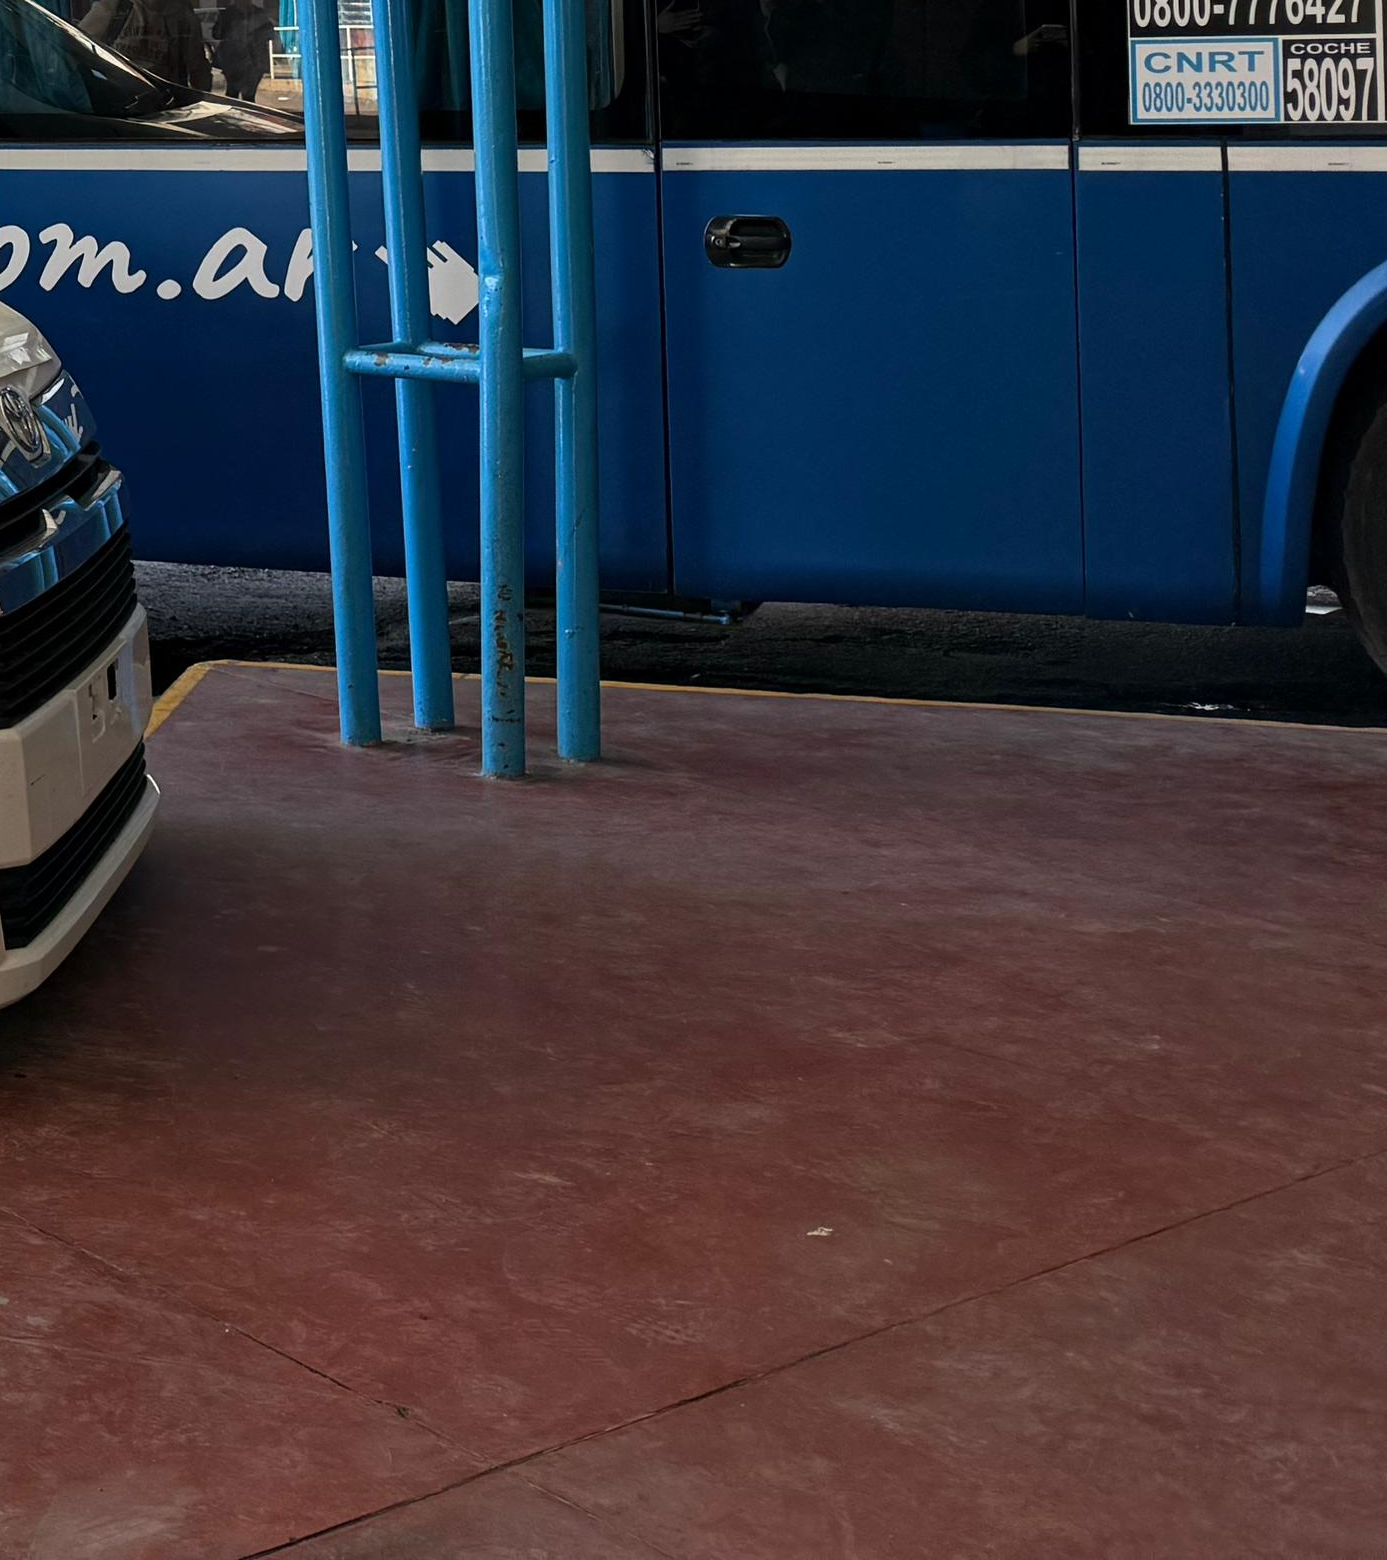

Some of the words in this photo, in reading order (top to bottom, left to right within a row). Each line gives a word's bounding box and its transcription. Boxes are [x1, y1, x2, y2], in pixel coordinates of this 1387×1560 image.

[1143, 50, 1265, 73] CNRT
[1290, 42, 1371, 54] COCHE
[1142, 80, 1268, 113] 0800-3330300
[1286, 57, 1374, 121] 58097
